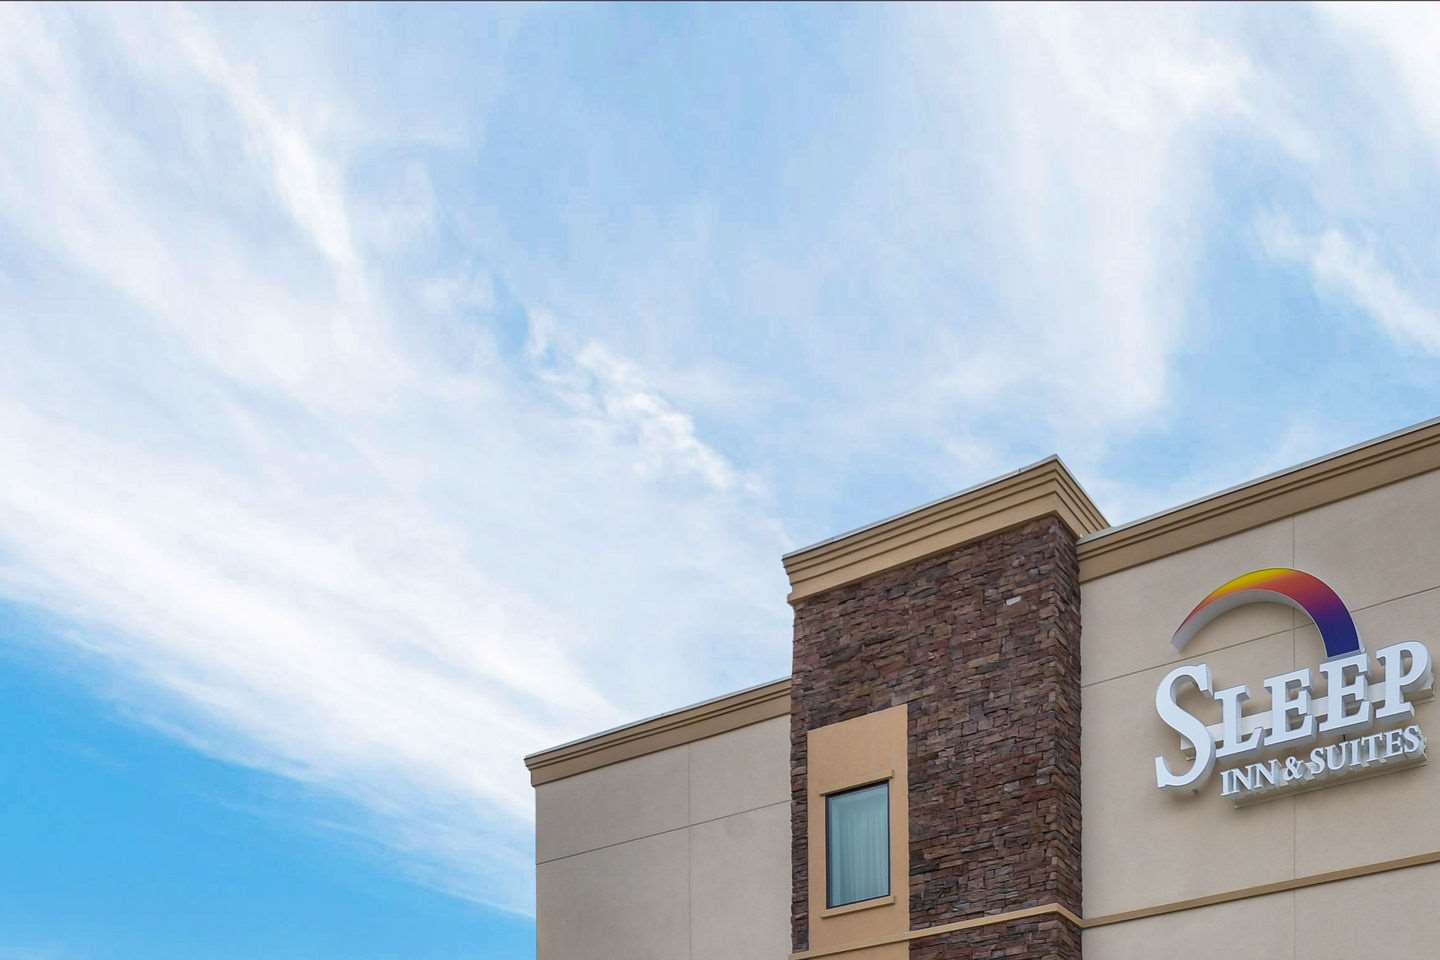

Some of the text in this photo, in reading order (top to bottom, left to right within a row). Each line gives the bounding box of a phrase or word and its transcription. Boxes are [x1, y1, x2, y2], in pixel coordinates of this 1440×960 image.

[1155, 640, 1432, 789] SLEEP
[1220, 725, 1424, 796] INN & SUITES
